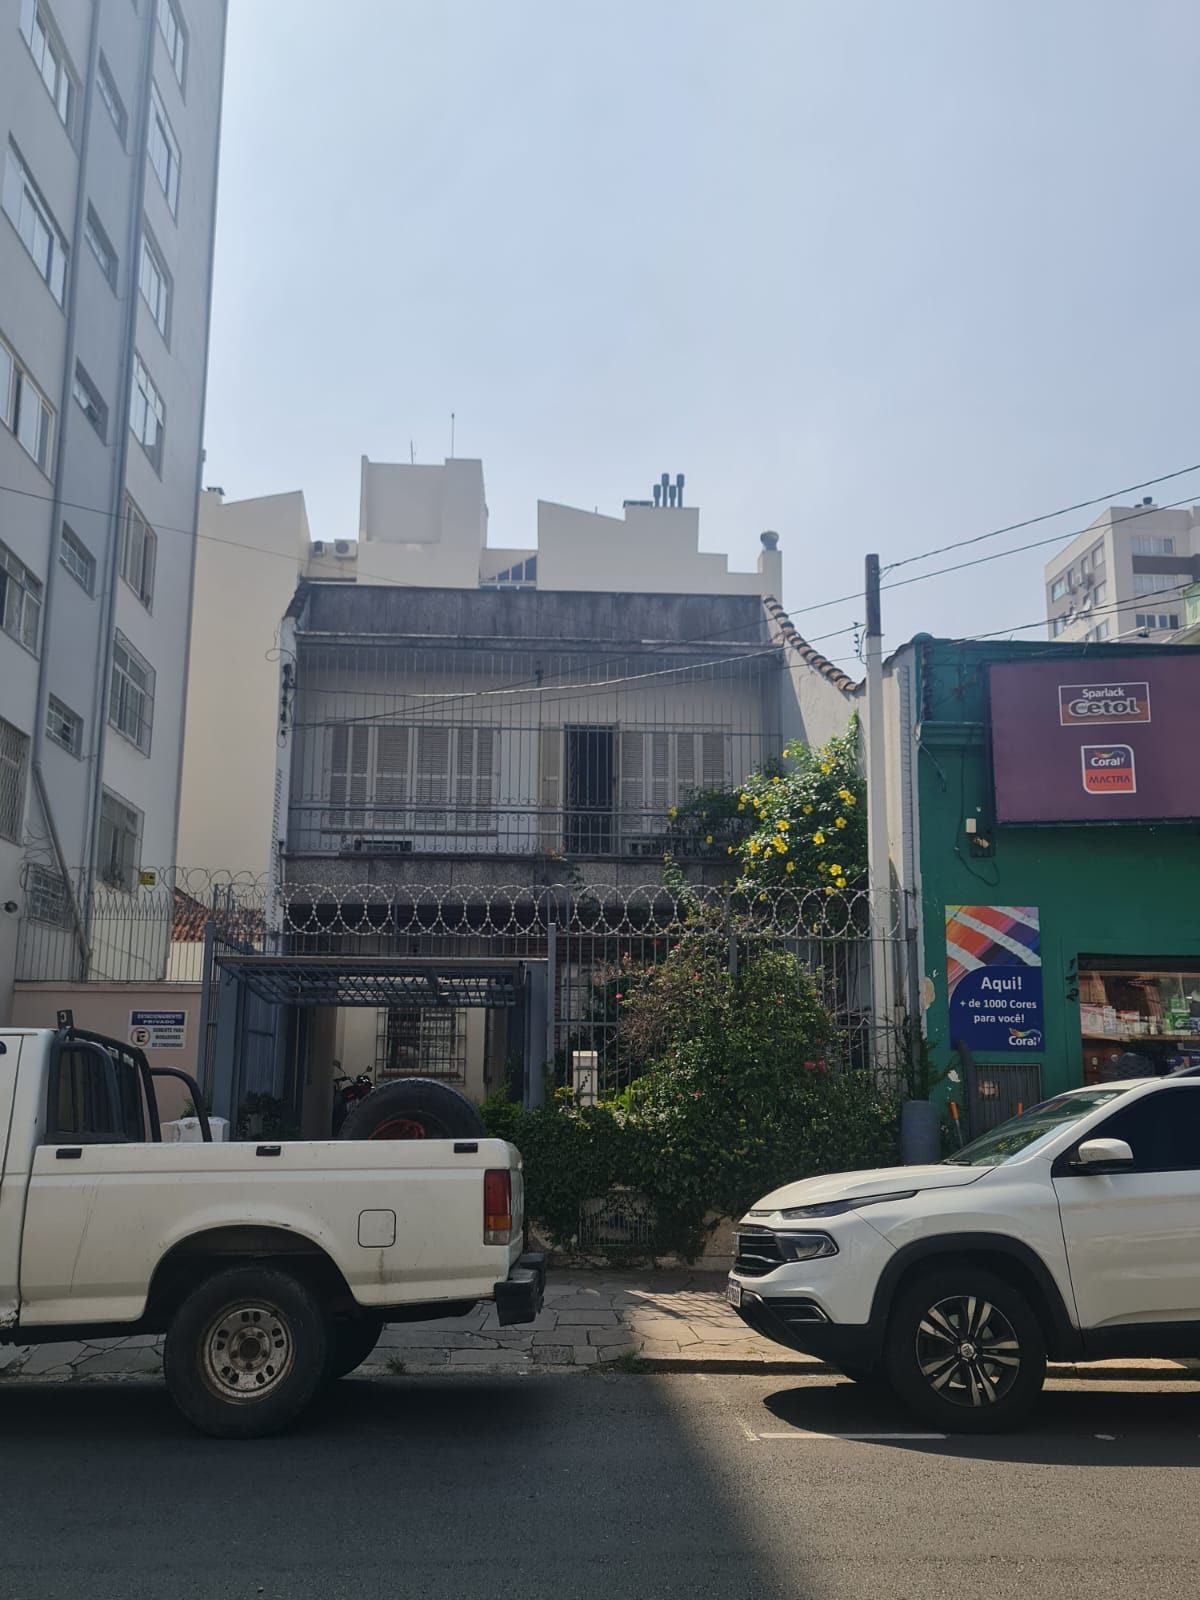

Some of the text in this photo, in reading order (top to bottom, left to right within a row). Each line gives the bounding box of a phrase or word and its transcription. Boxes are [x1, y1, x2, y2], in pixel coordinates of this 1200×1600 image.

[1082, 687, 1125, 699] Sparlack
[1069, 698, 1141, 716] Cetol
[1091, 757, 1120, 767] Coral
[981, 976, 1022, 993] Aqui!
[968, 998, 981, 1008] de
[984, 1000, 1007, 1008] 1000
[1009, 1000, 1037, 1009] Cores
[974, 1014, 1025, 1024] para você!
[1008, 1036, 1037, 1046] Coral
